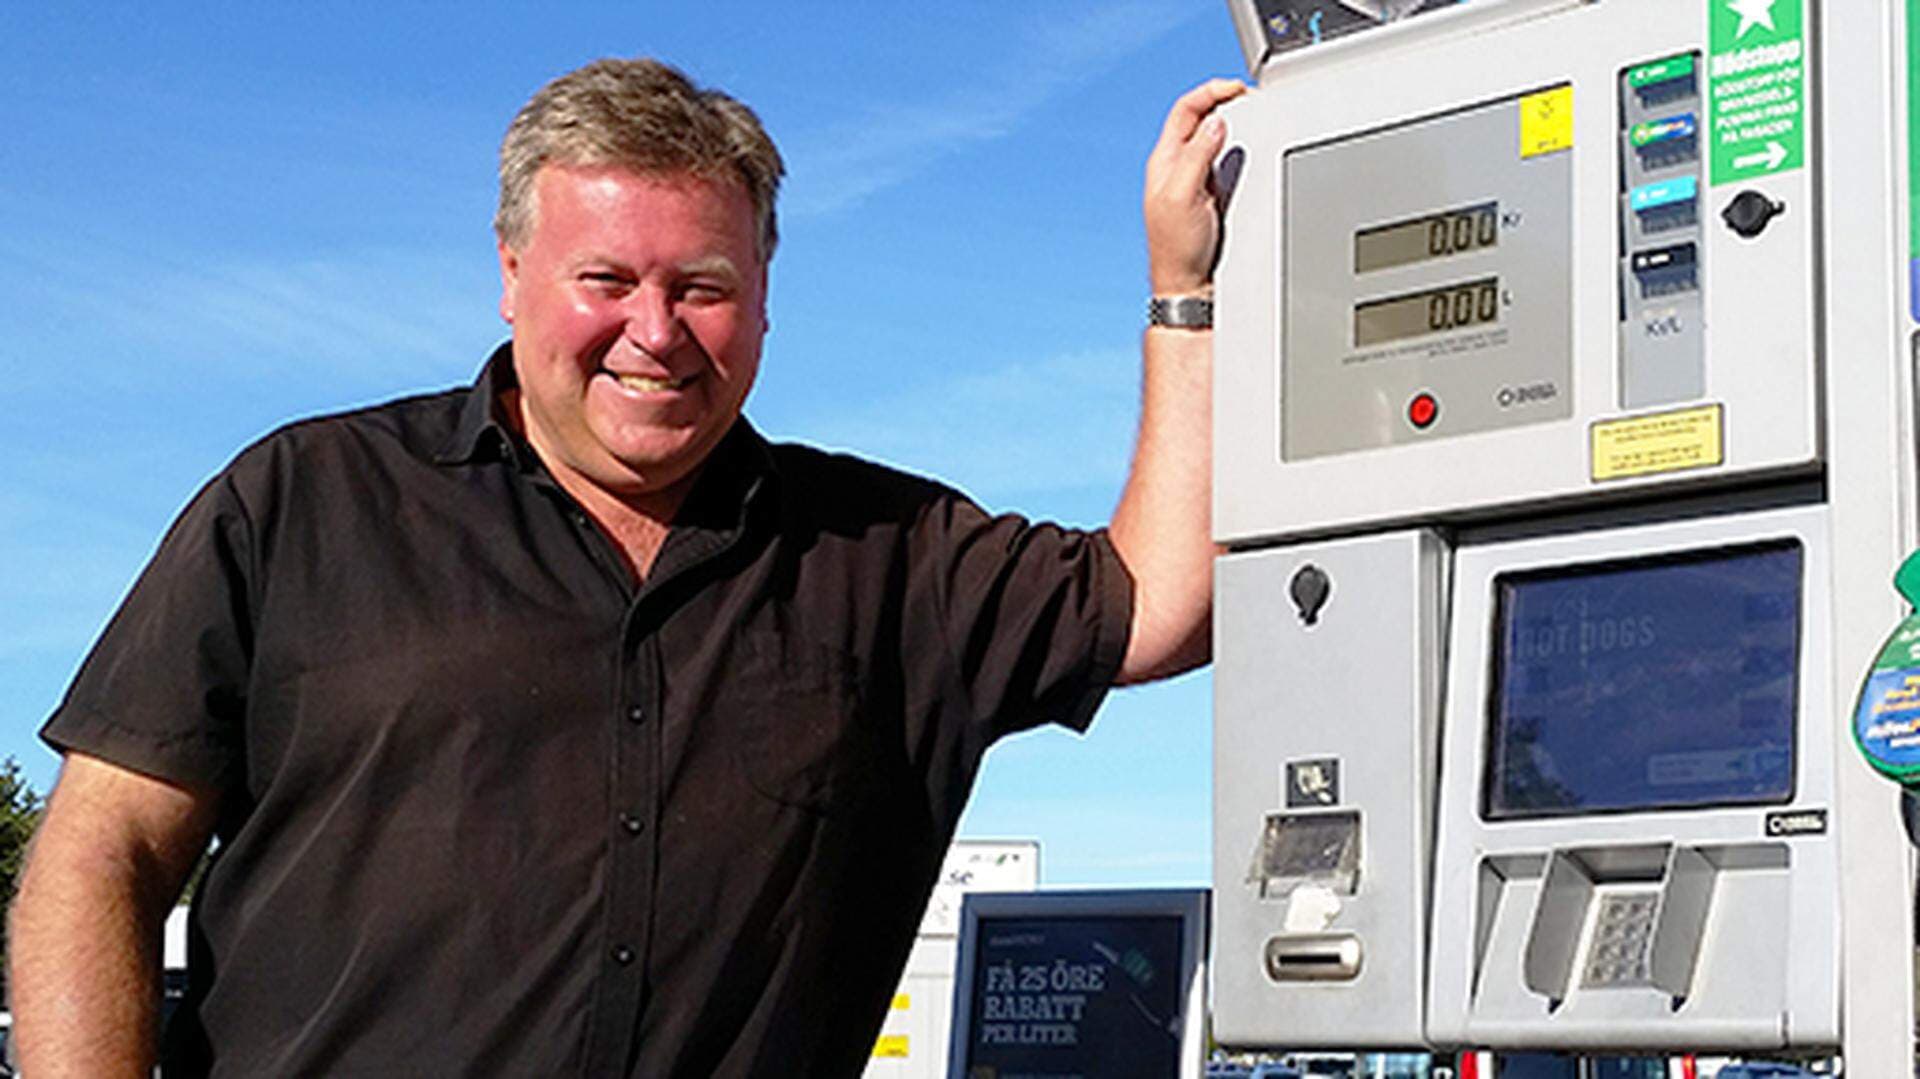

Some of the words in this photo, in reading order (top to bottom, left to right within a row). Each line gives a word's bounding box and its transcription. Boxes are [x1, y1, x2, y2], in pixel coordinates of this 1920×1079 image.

[1429, 211, 1497, 256] 0.00
[1429, 286, 1497, 331] 0.00
[986, 960, 1016, 991] FÅ
[1050, 959, 1106, 991] ÖRE
[983, 994, 1087, 1021] RABATT
